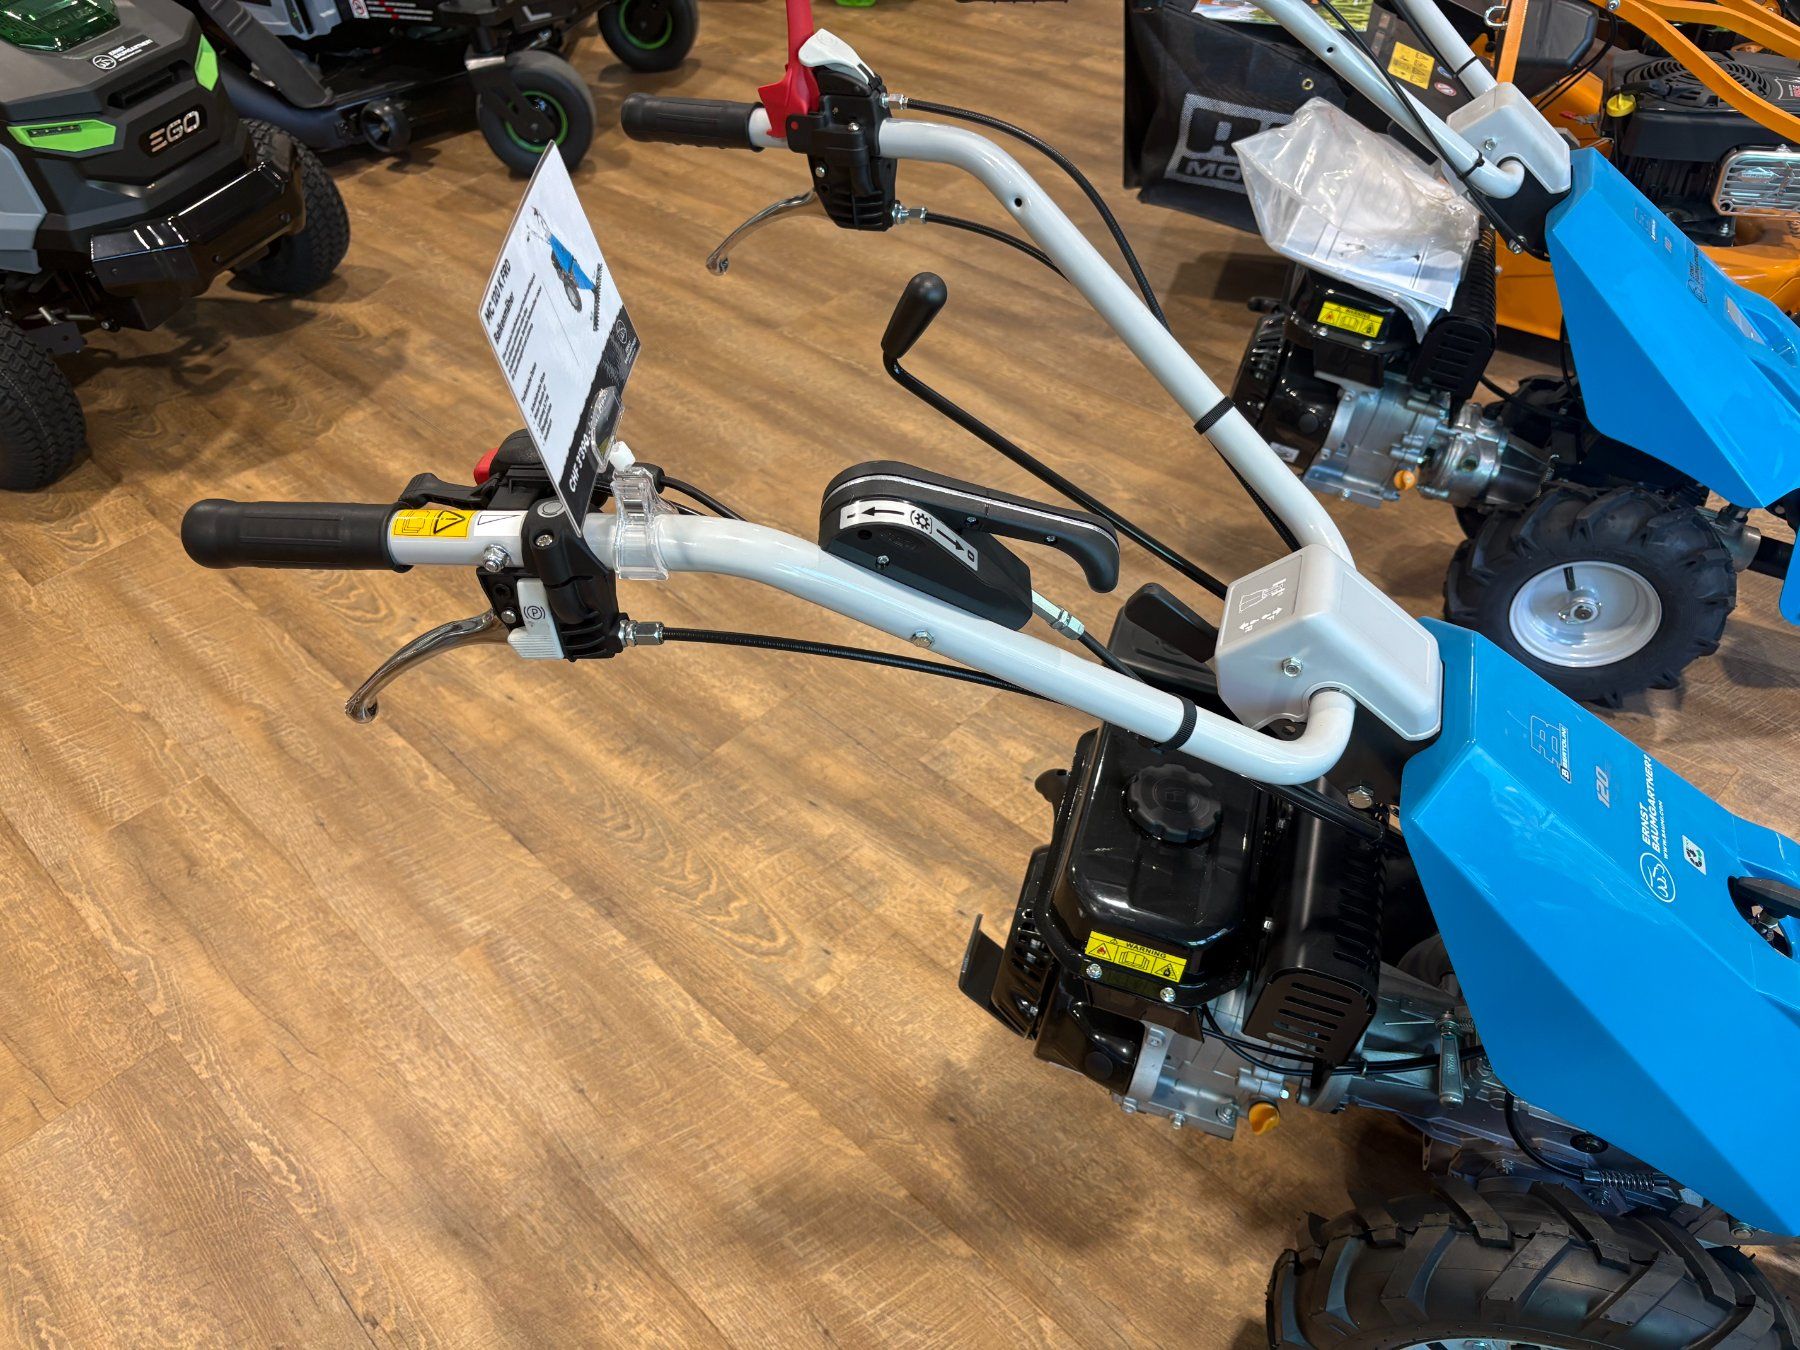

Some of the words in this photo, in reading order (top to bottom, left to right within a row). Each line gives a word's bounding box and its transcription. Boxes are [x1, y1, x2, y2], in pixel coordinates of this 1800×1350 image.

[149, 110, 200, 153] EGO
[569, 462, 580, 493] CHF
[1595, 765, 1610, 808] 120
[1639, 801, 1651, 846] ERNST
[1126, 942, 1167, 959] WARNING
